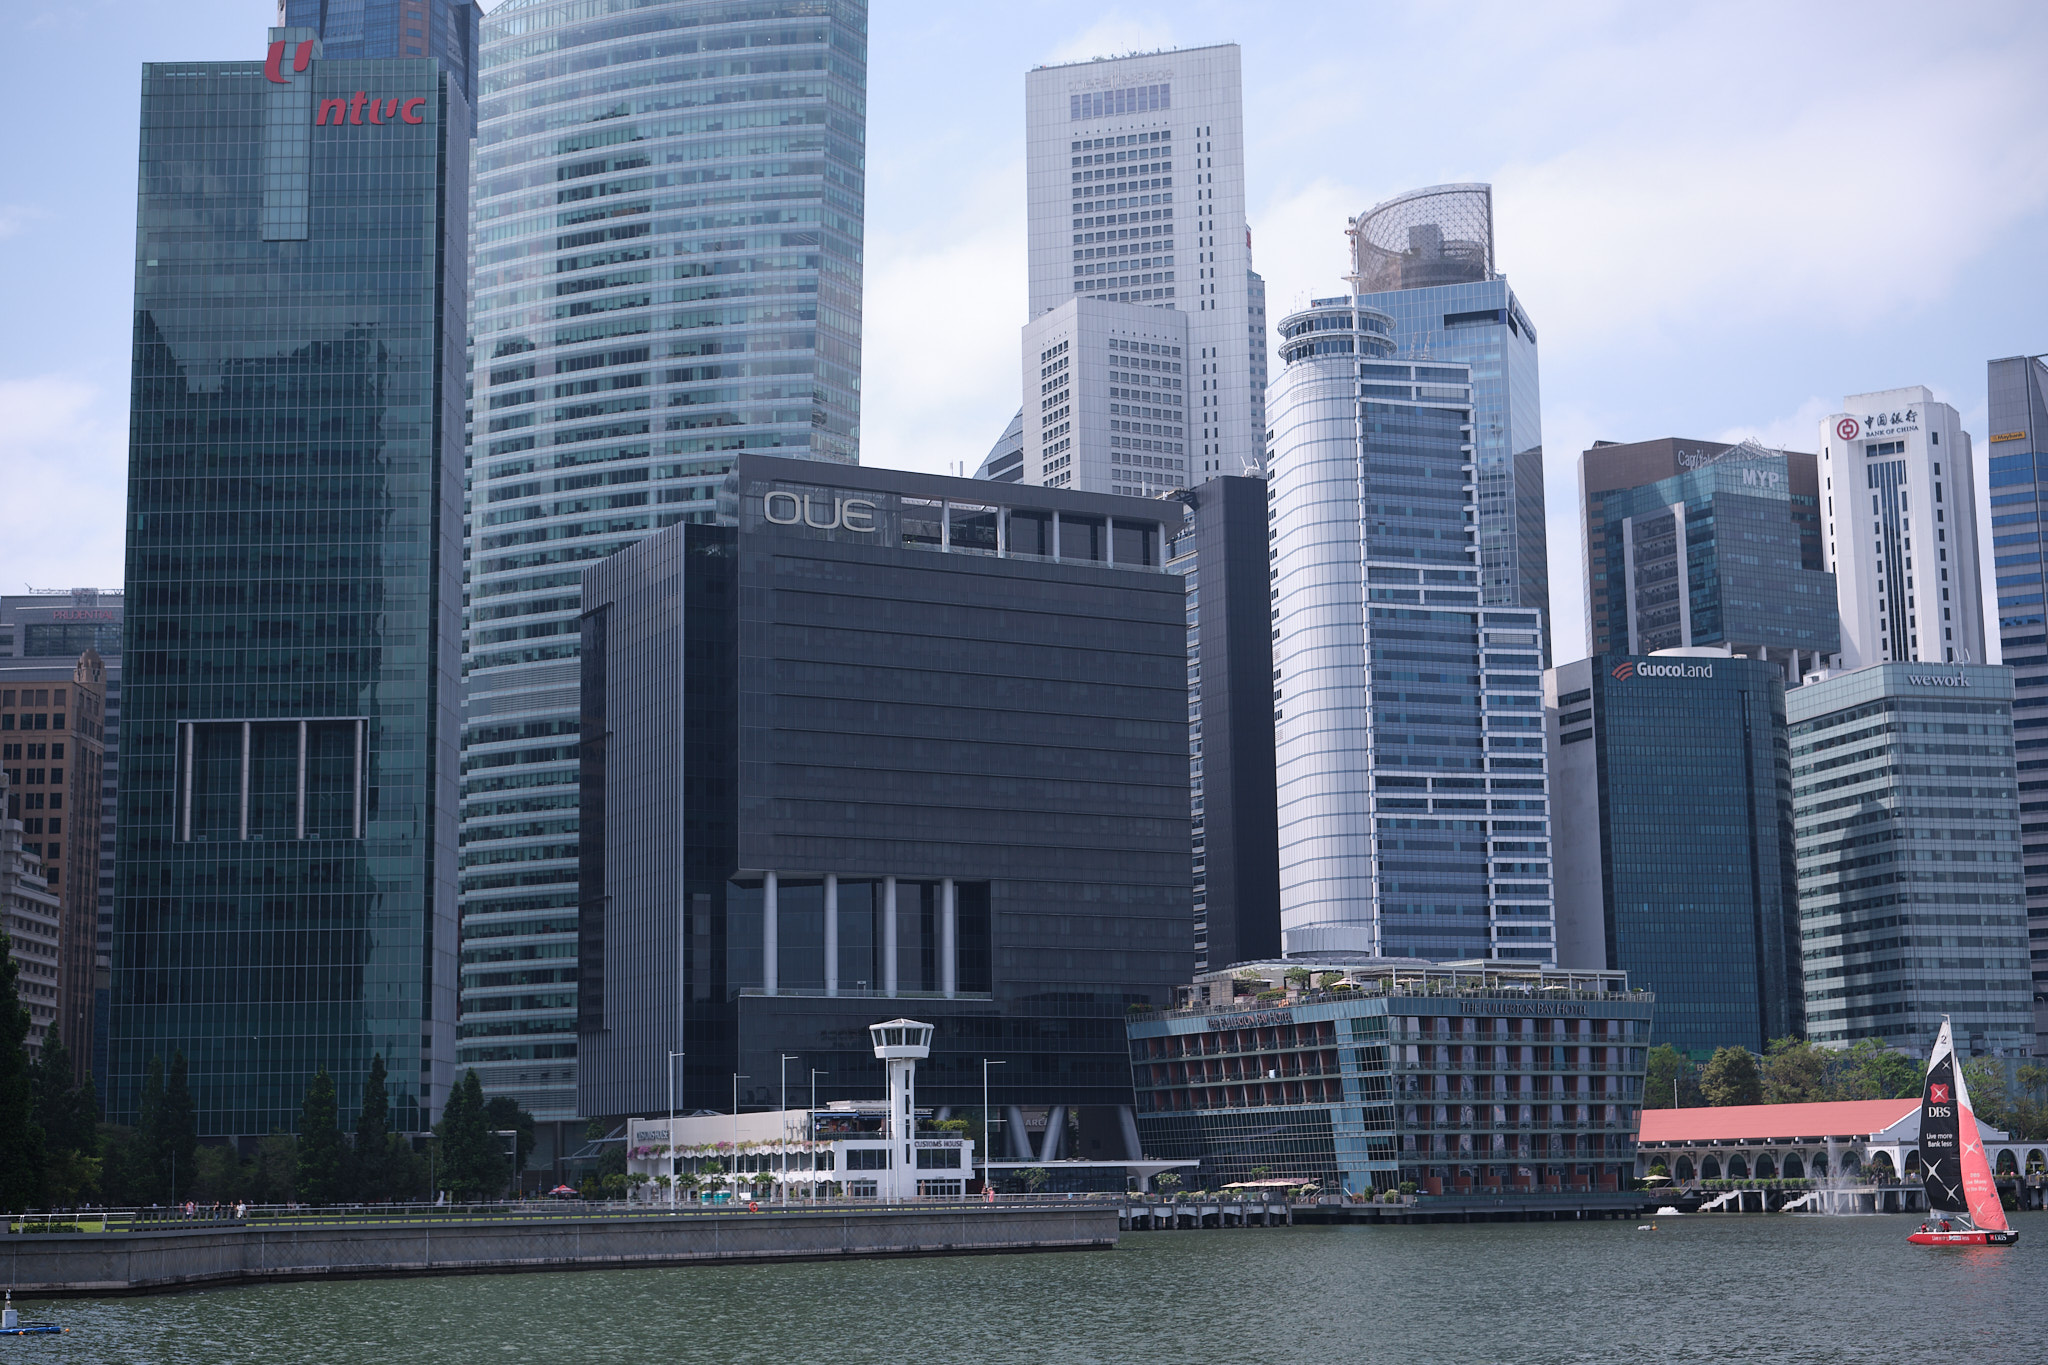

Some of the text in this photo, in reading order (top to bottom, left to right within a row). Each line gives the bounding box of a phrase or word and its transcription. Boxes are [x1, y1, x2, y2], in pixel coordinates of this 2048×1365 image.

[317, 90, 426, 125] ntuc
[1866, 429, 1885, 437] BANK
[1896, 425, 1919, 434] CHINA
[1742, 468, 1780, 488] MYP
[763, 491, 877, 533] OUE
[53, 609, 115, 621] PRUDENTIAL
[1908, 671, 1972, 687] wework
[1461, 1002, 1588, 1015] THE FULLERTON BAY HOTEL
[1941, 1034, 1947, 1044] 2
[1928, 1106, 1951, 1118] DBS
[914, 1140, 963, 1148] CUSTOMS HOUSE
[1941, 1140, 1953, 1148] less
